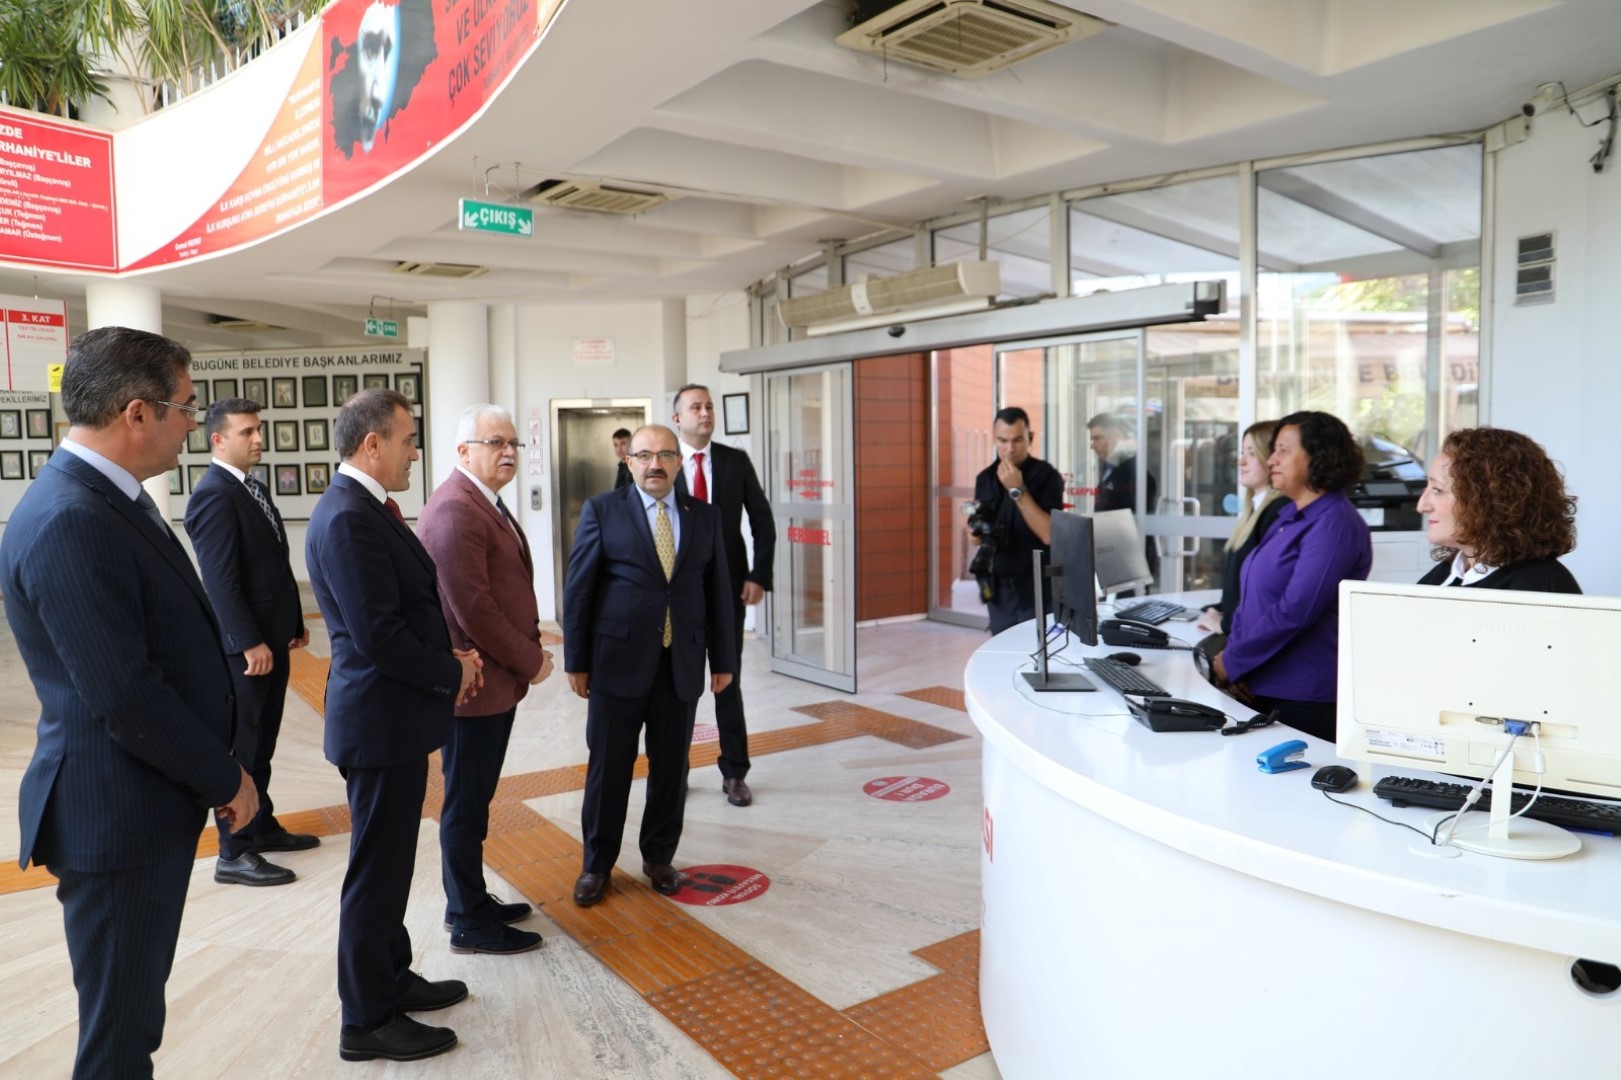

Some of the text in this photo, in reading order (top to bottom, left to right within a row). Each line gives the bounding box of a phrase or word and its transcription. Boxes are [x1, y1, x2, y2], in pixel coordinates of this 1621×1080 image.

[457, 7, 470, 45] VE
[448, 53, 470, 107] ÇOK
[480, 207, 517, 229] ÇIKIŞ
[21, 313, 51, 323] 3. KAT
[192, 353, 403, 371] BUGÜNE BELEDİYE BAŞKANLARIMIZ
[0, 395, 47, 403] EKİLLERİMİZ
[787, 527, 831, 545] PERSONEL
